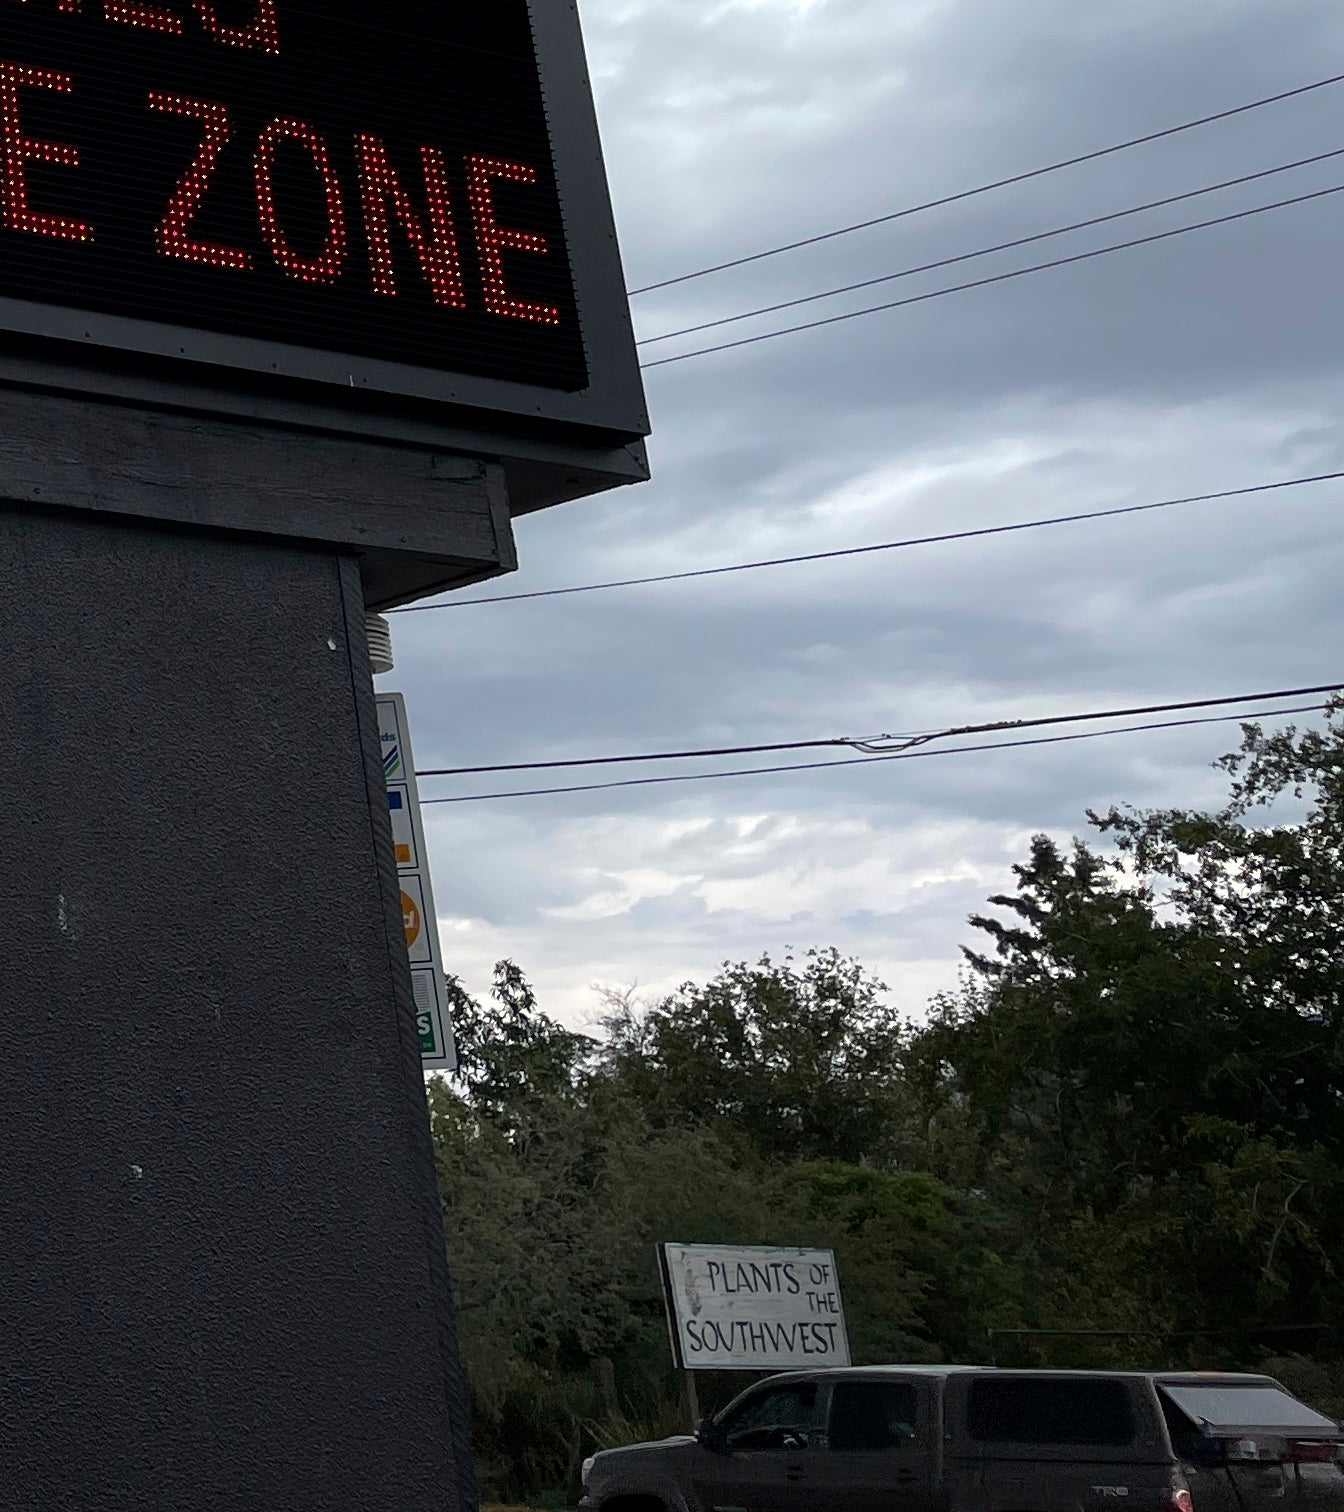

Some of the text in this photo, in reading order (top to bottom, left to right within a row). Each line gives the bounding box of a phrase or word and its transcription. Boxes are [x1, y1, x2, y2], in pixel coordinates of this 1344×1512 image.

[146, 90, 561, 327] ZONE
[707, 1261, 830, 1295] PLANTS OF
[806, 1291, 840, 1314] THE
[686, 1319, 838, 1354] SOUTHWEST
